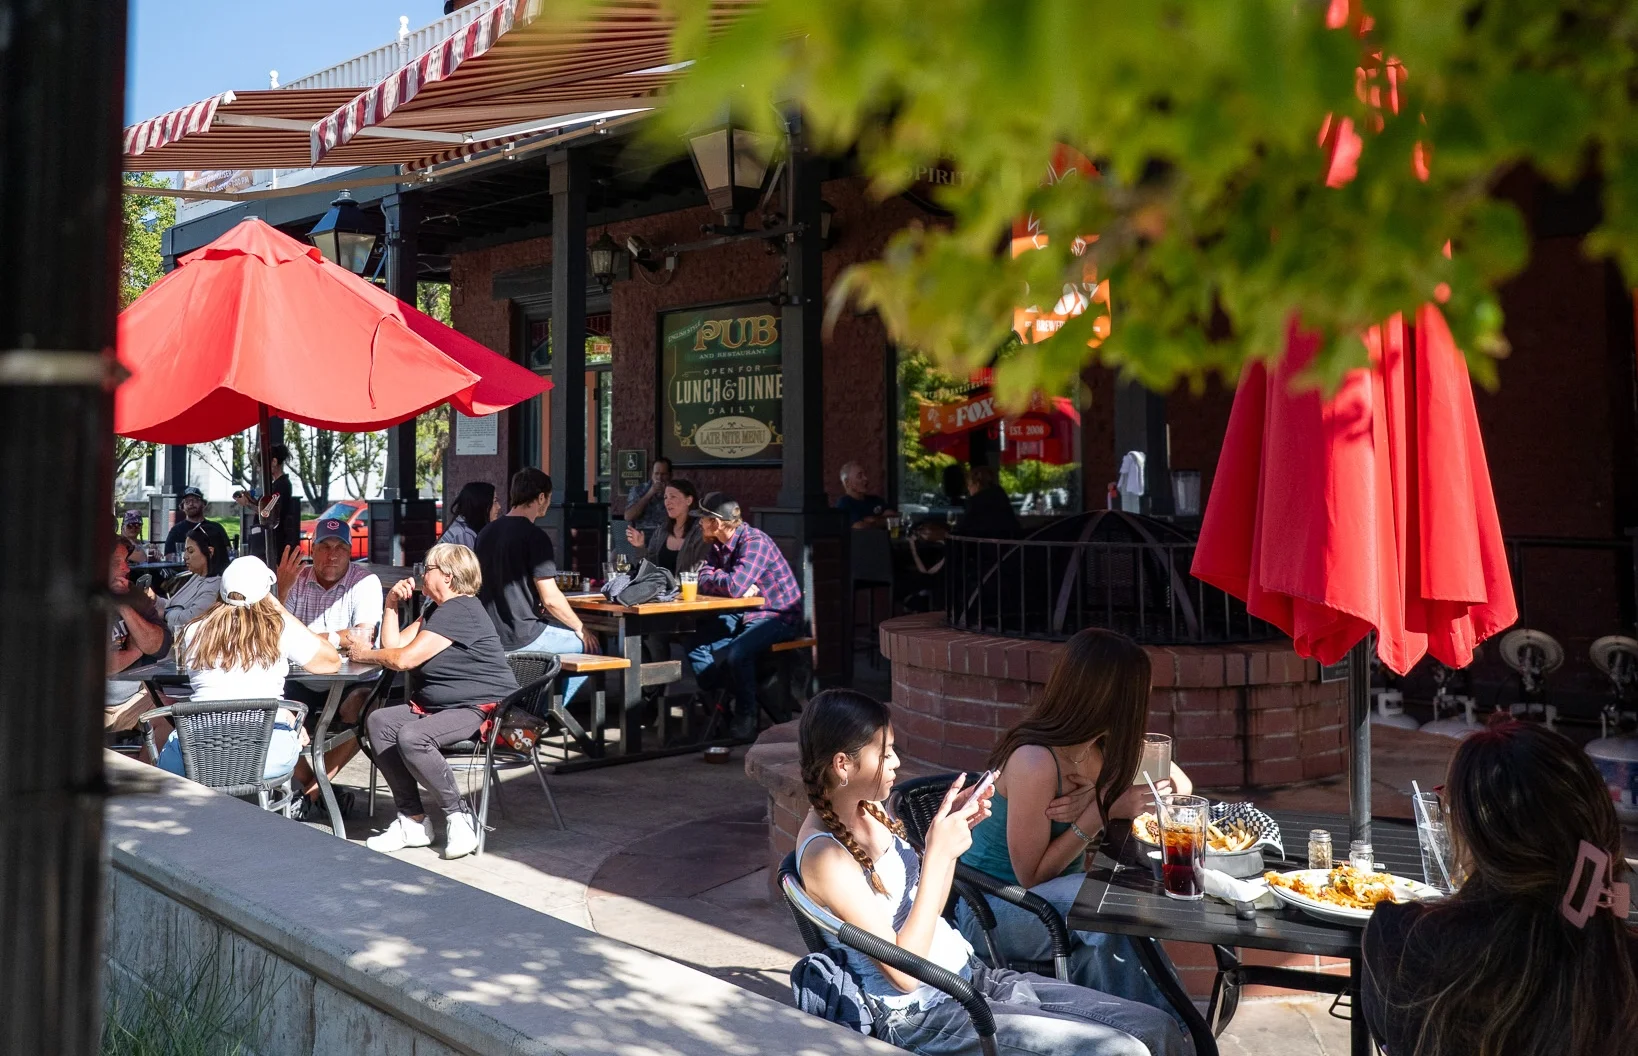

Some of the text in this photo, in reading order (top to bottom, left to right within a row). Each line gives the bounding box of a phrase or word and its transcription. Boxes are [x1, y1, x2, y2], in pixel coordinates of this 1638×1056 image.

[694, 315, 778, 351] PUB
[699, 349, 767, 360] AND RESTAURANT
[703, 364, 761, 376] OPEN FOR
[676, 374, 783, 406] LUNCH & DINNE
[708, 405, 756, 415] DAILY
[956, 397, 995, 427] FOX
[701, 429, 766, 445] LATE NITE MENU
